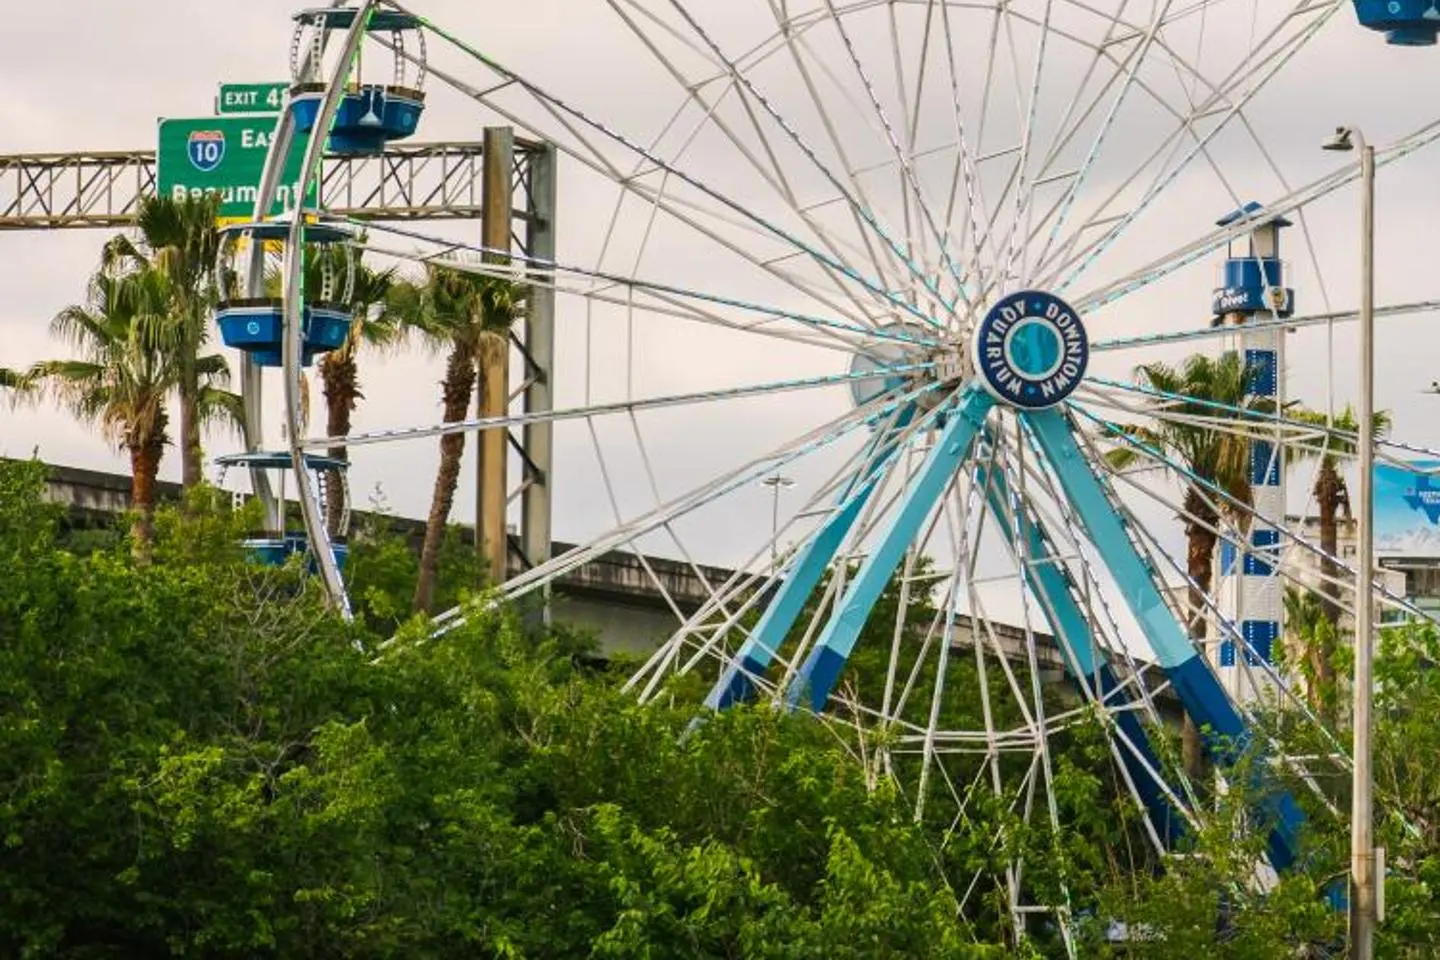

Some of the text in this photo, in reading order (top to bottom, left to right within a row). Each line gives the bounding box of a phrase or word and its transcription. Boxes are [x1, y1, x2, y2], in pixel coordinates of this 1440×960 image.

[225, 91, 258, 105] EXIT
[196, 143, 219, 162] 10
[986, 300, 1026, 396] AQUARIUM
[1040, 303, 1082, 399] DOWNTOWN
